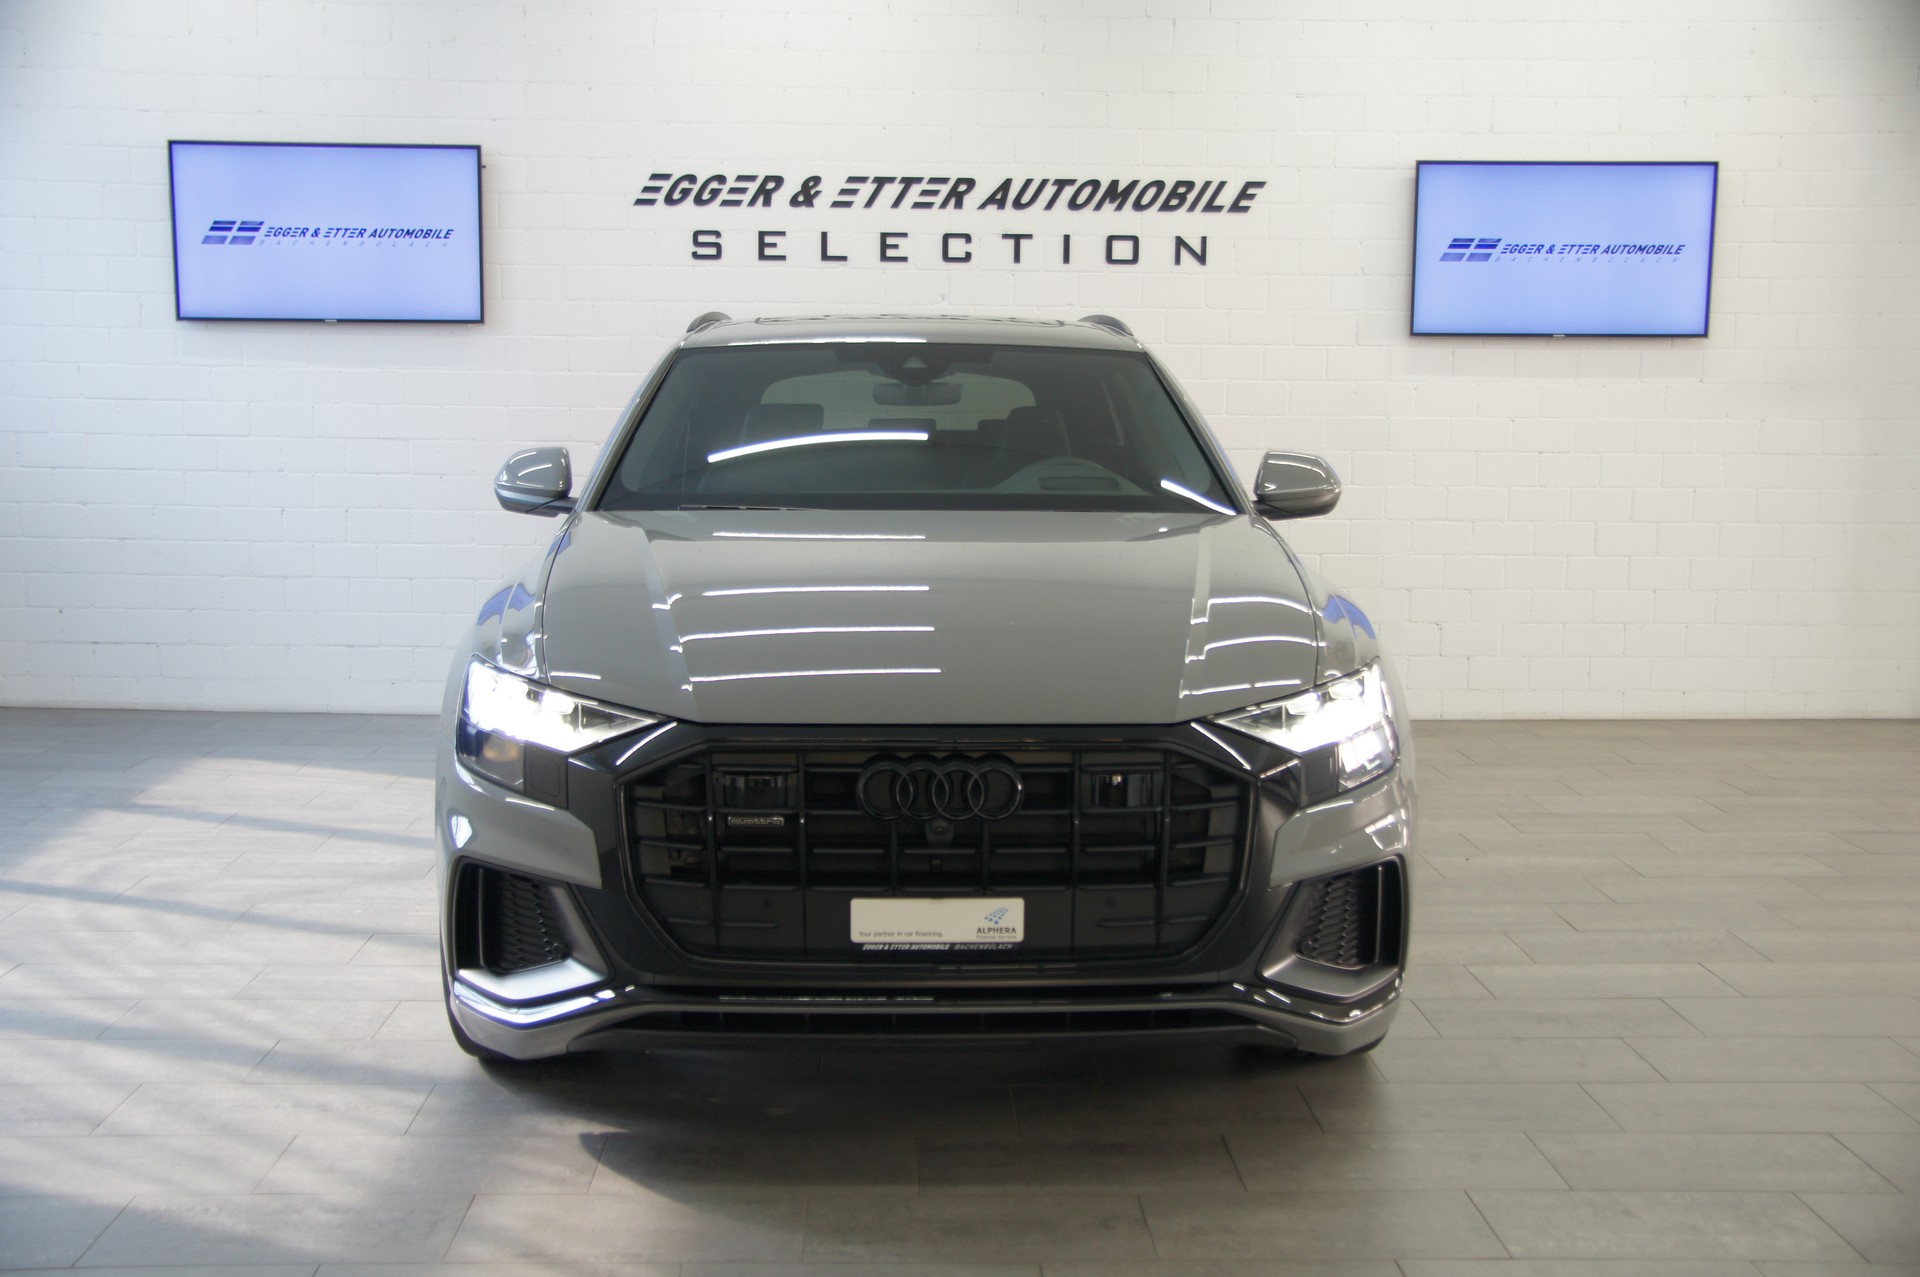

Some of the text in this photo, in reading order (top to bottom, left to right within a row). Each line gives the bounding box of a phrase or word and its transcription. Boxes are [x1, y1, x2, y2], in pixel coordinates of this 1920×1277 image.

[633, 173, 1267, 214] EGGER & ETTER AUTOMOBILE
[264, 226, 454, 240] EGGER & ETTER AUTOMOBILE
[691, 230, 1208, 266] SELECTION
[1501, 243, 1685, 255] EGGER & ETTER AUTOMOBILE
[976, 927, 1017, 935] ALPHERA
